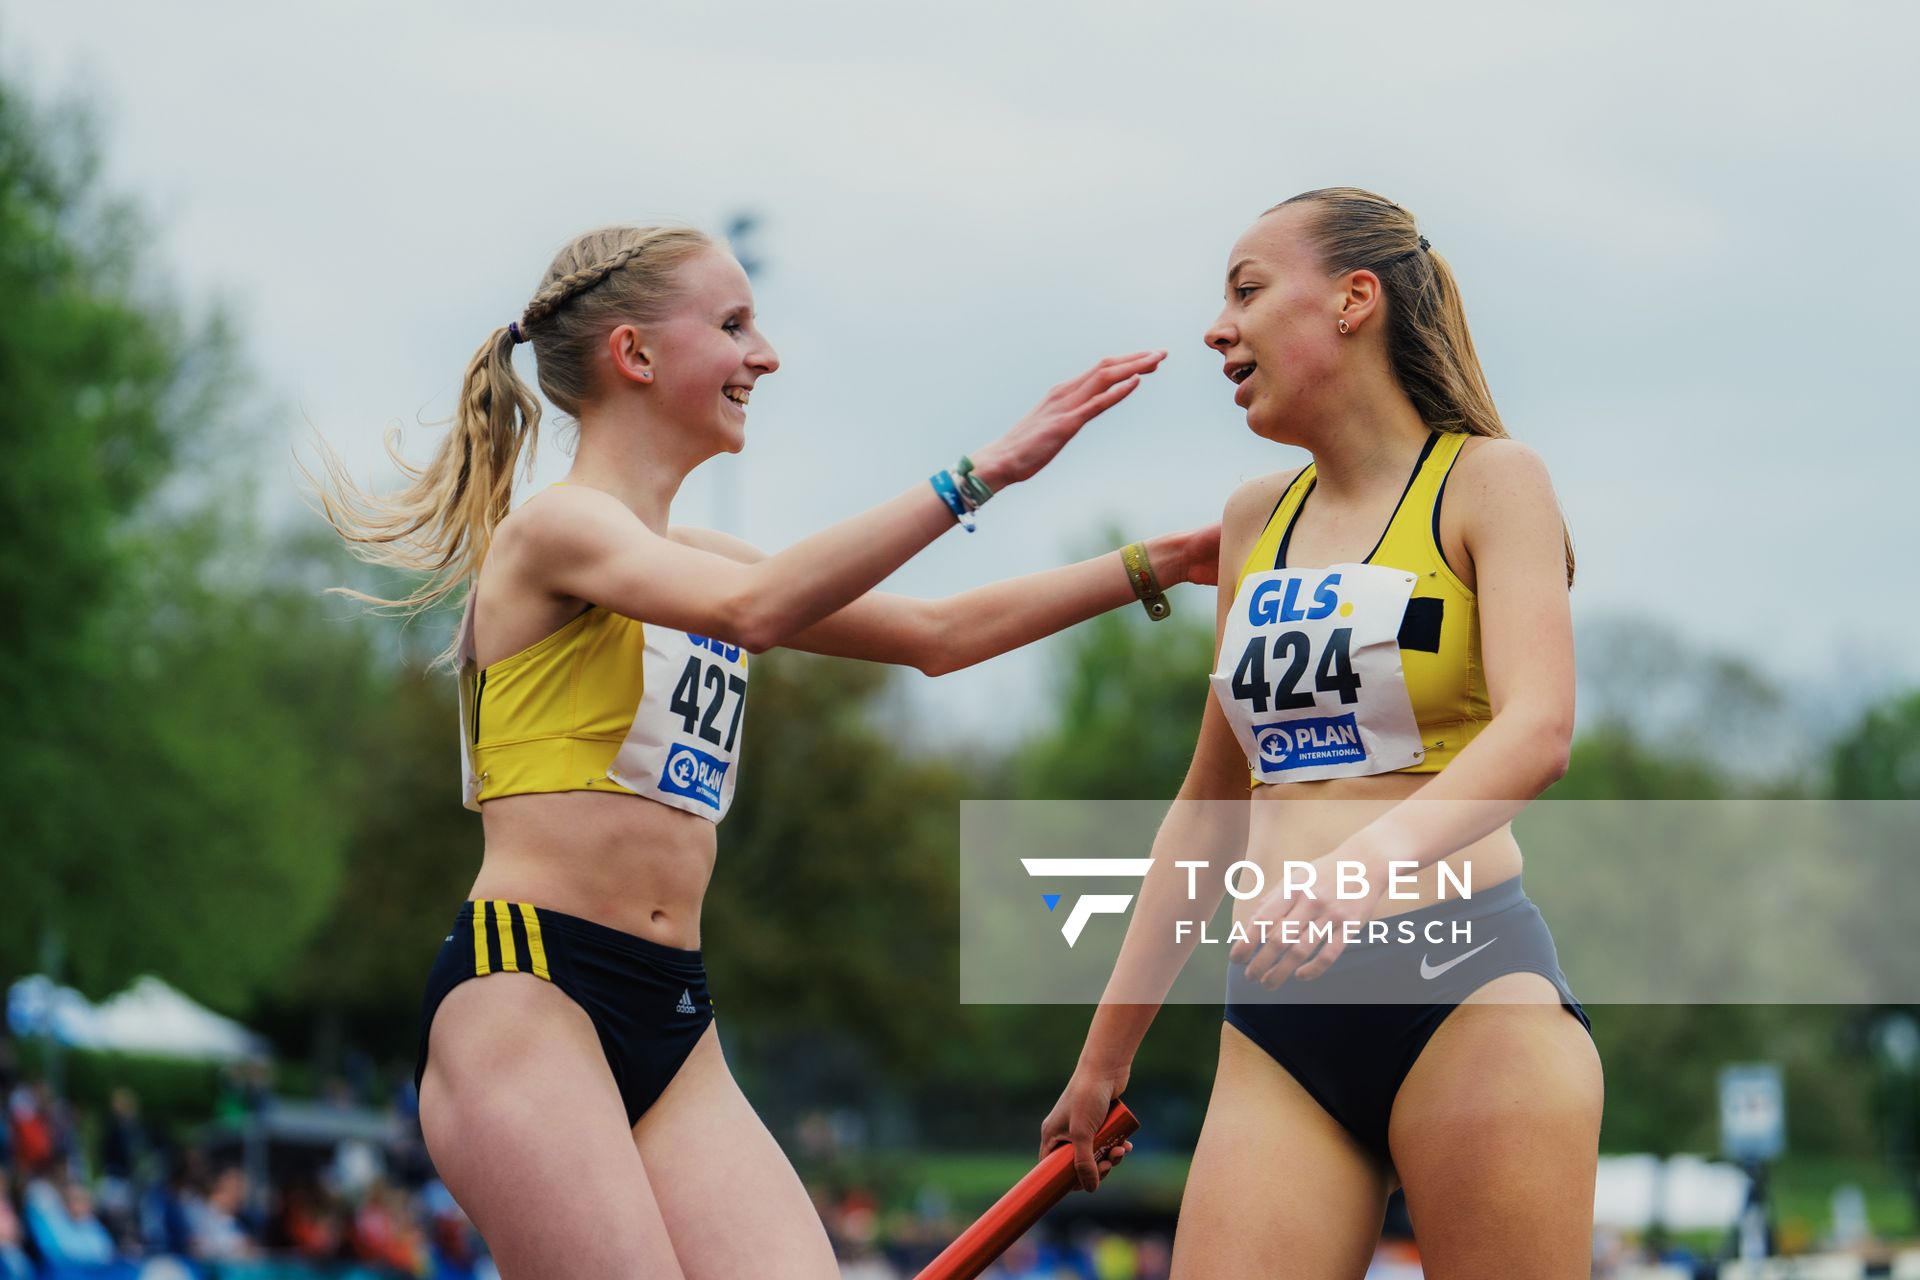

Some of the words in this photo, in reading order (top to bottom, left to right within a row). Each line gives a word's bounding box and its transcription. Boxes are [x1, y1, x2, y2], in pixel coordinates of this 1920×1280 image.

[1231, 627, 1362, 713] 424
[670, 656, 747, 753] 427
[1296, 725, 1357, 748] PLAN
[1299, 748, 1361, 760] INTERNATIONAL
[699, 762, 723, 792] PLAN
